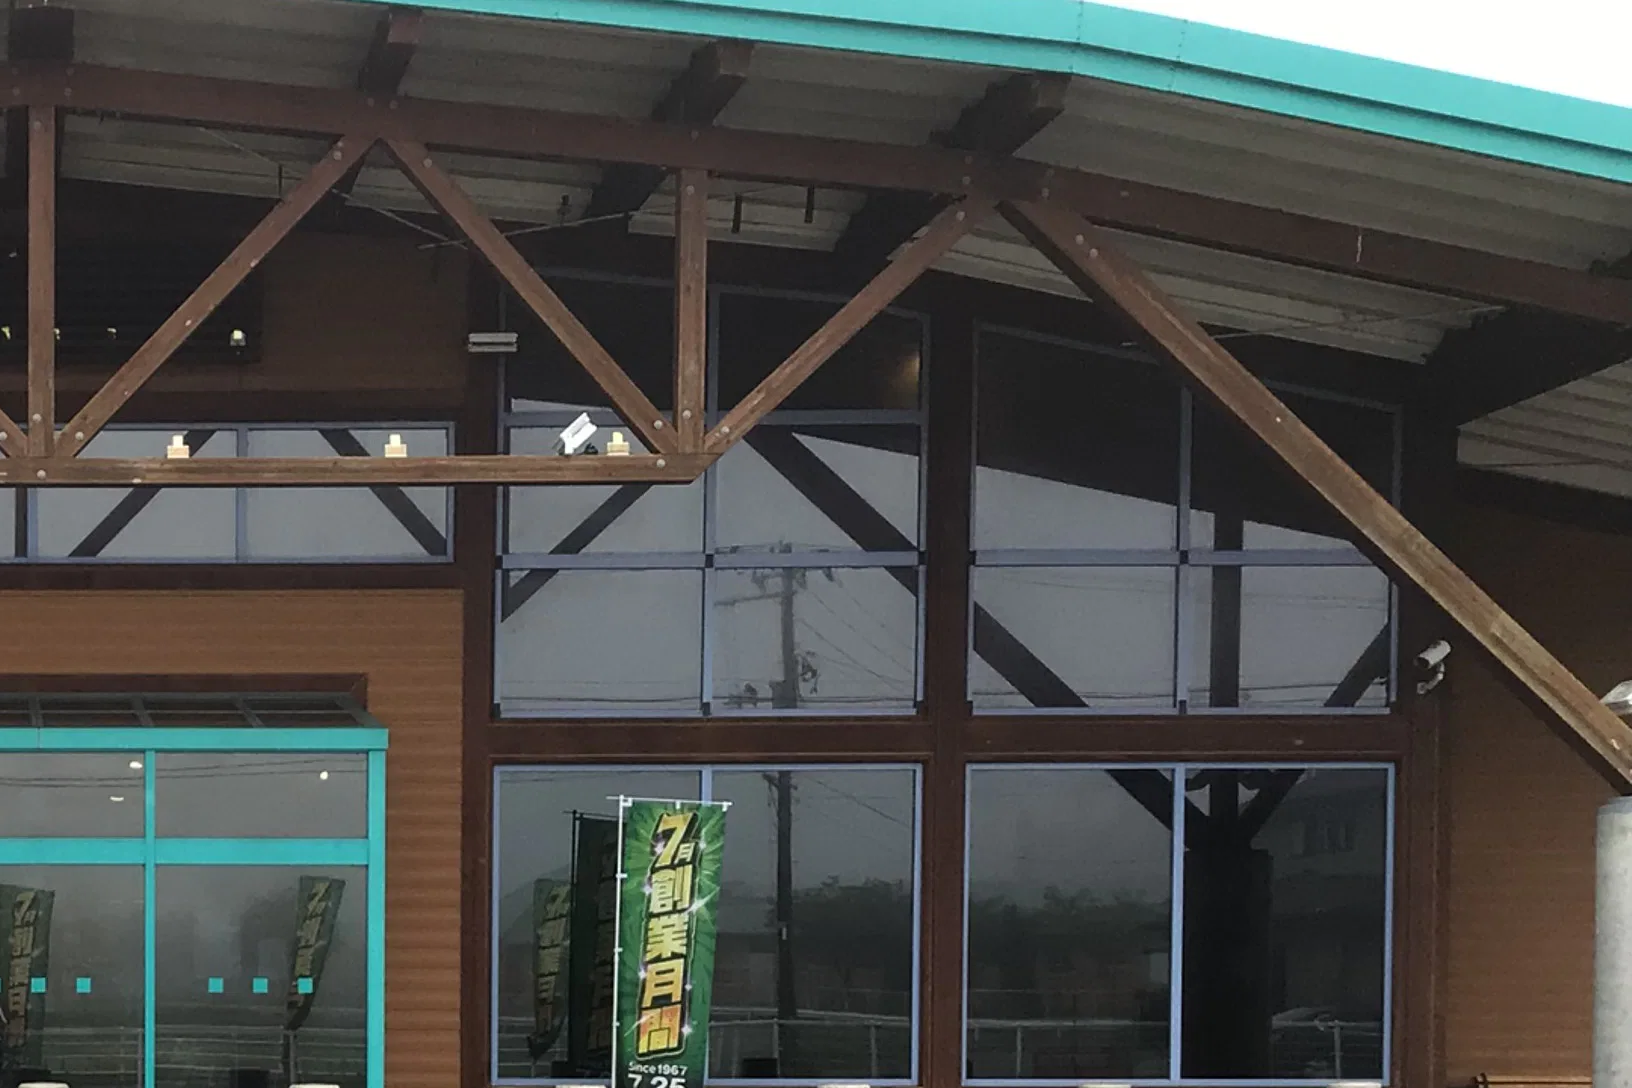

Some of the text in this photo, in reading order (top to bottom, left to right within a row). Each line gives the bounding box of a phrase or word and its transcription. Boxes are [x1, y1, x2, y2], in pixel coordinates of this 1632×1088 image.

[638, 812, 694, 1055] 7月創業月間
